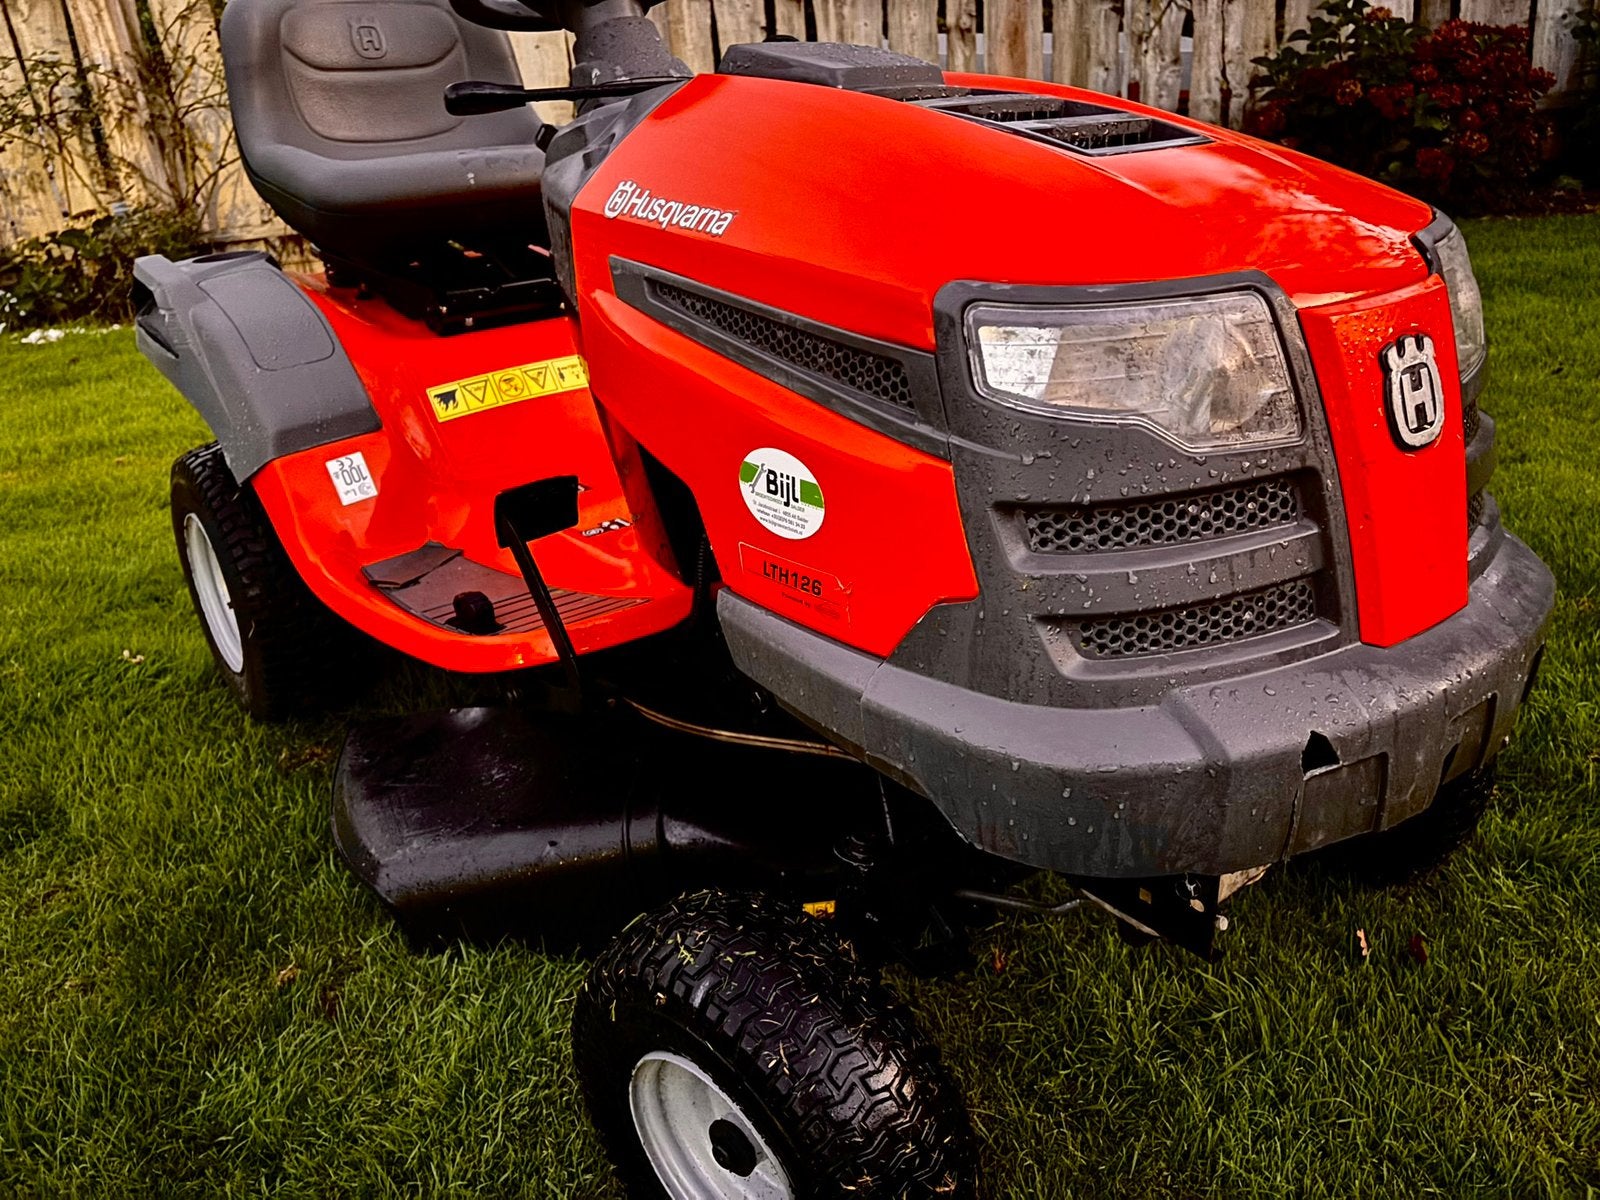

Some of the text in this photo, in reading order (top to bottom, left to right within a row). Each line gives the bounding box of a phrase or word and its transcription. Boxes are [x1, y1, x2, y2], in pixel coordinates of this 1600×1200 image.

[622, 187, 735, 236] Husqvarna
[341, 464, 368, 486] 100
[766, 468, 799, 507] Bijl
[763, 560, 822, 597] LTH126
